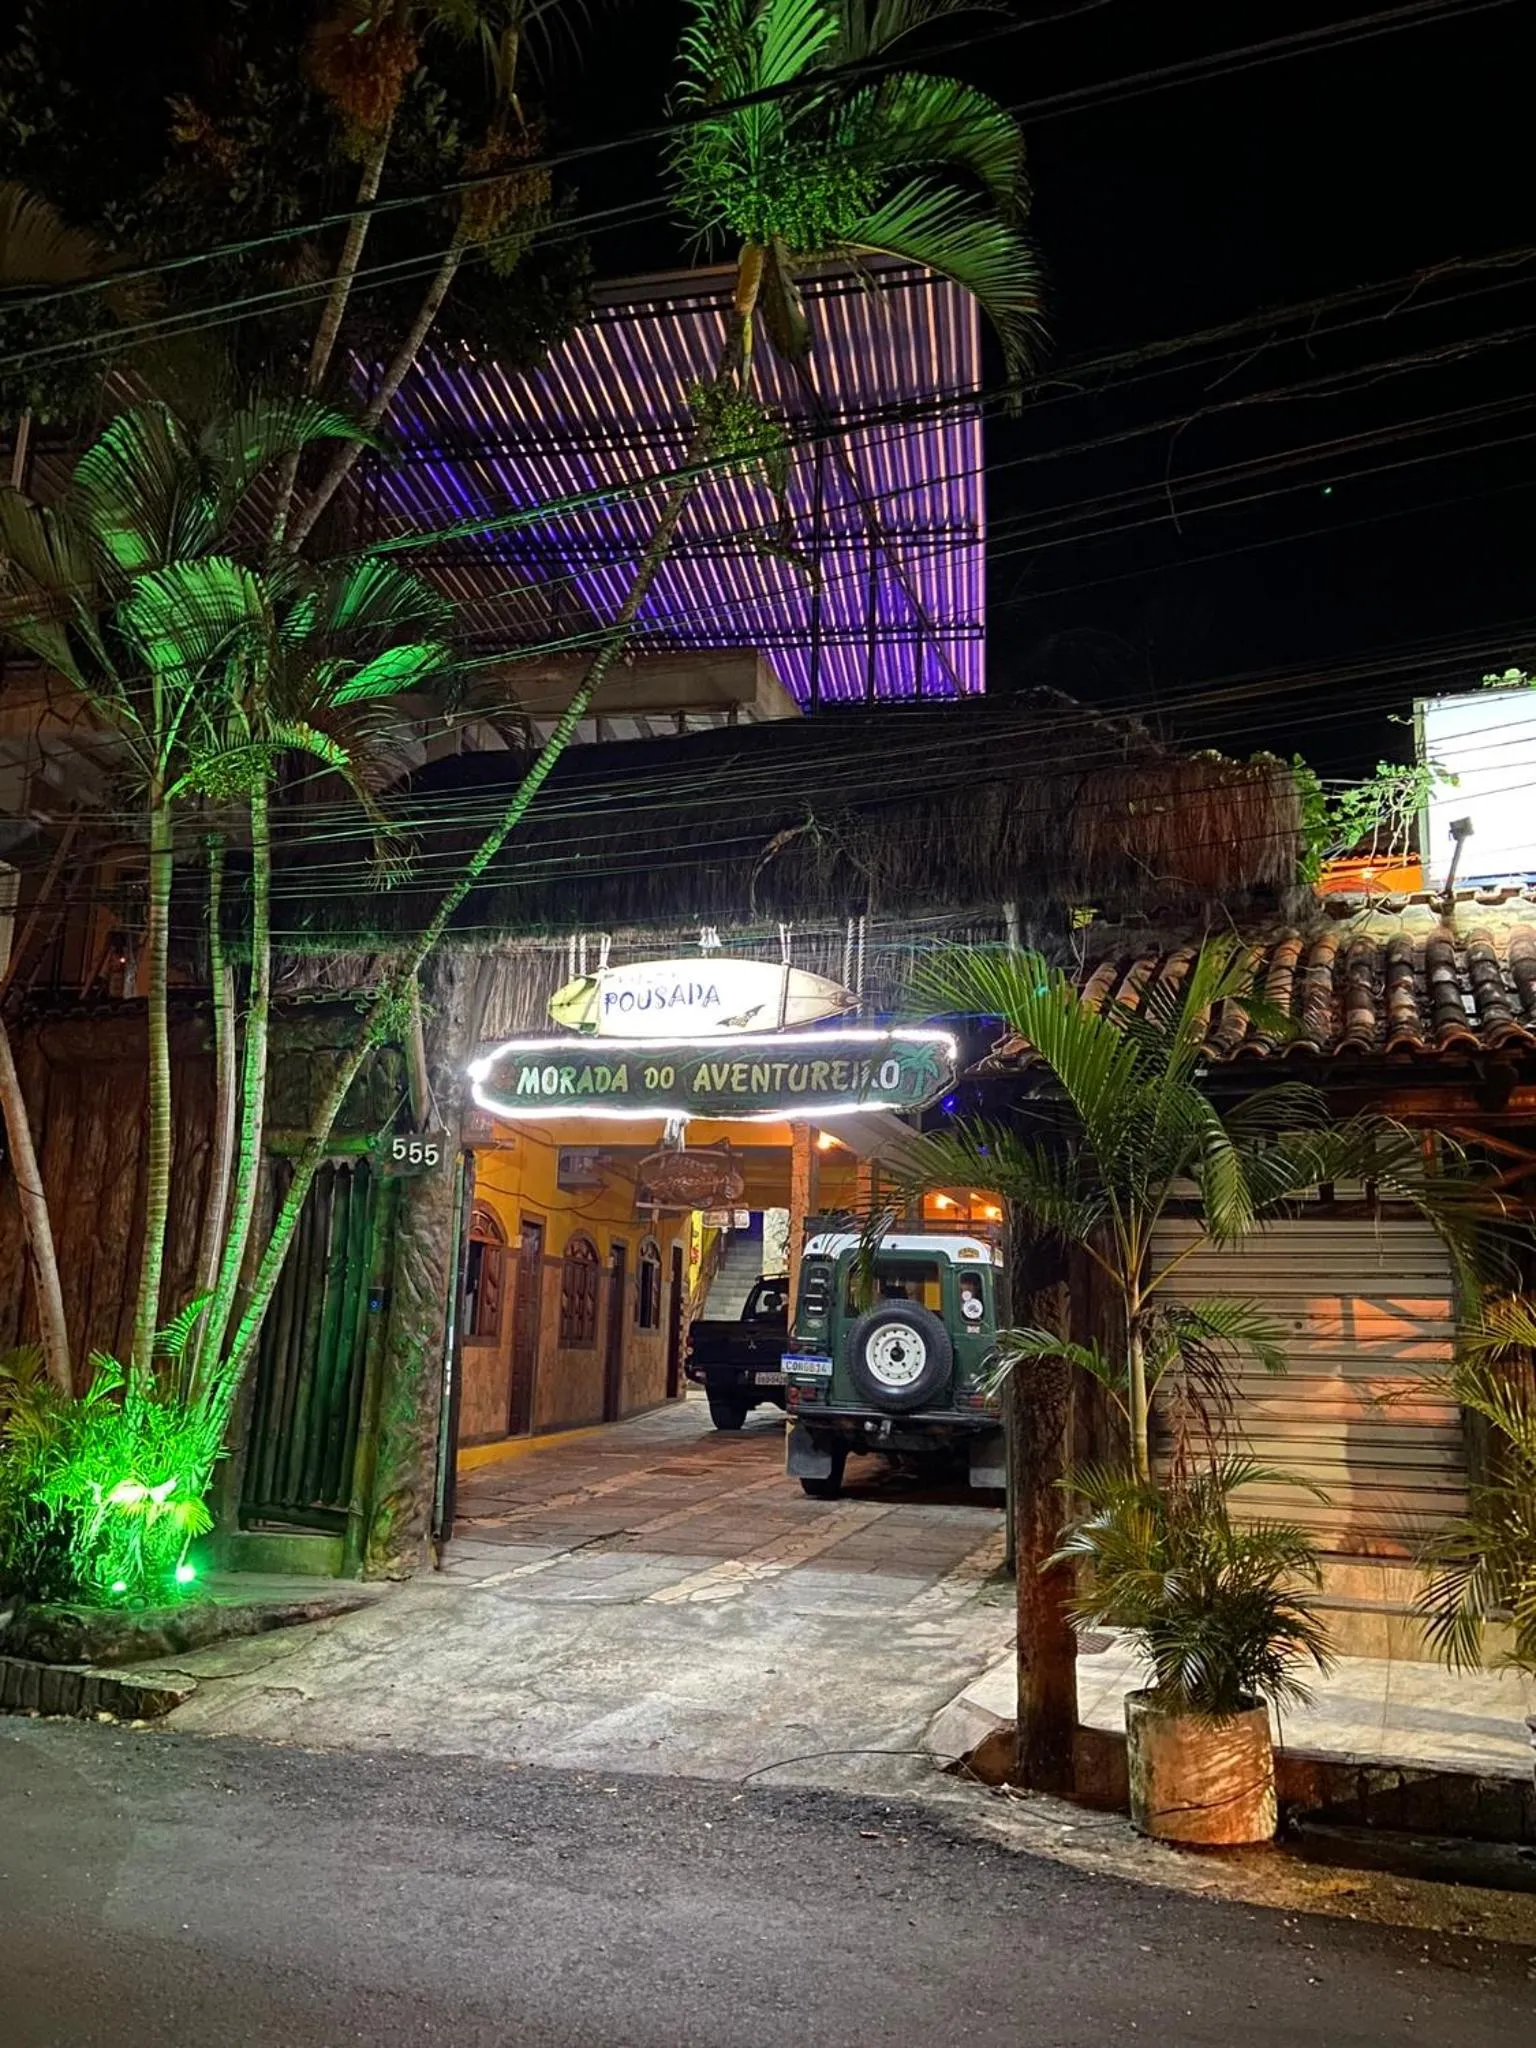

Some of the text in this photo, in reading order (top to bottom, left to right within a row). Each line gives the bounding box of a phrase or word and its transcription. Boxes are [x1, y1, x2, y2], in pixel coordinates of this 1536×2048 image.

[605, 983, 721, 1015] POUSADA
[516, 1064, 629, 1095] MORADA
[644, 1066, 675, 1090] DO
[392, 1138, 440, 1166] 555
